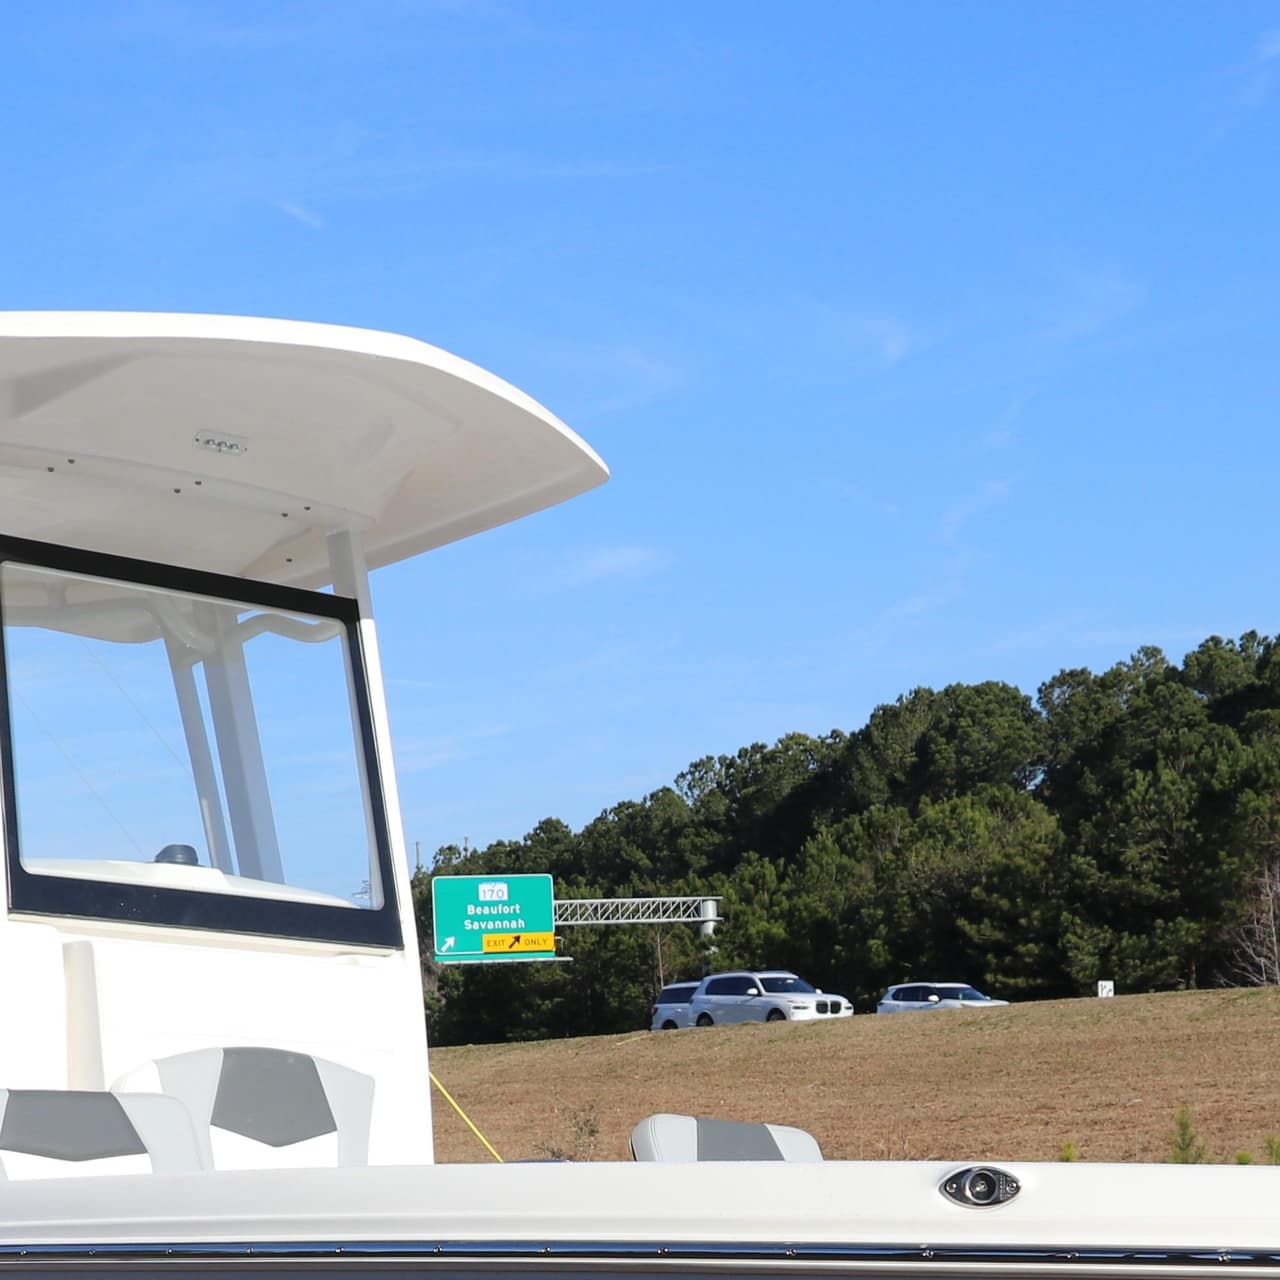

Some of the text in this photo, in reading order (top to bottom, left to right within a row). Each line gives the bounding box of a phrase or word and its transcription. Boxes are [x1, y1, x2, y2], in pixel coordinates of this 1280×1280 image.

[482, 888, 505, 899] 170
[467, 903, 521, 916] Beaufort
[464, 918, 526, 931] Savannah
[486, 936, 549, 948] EXIT ONLY
